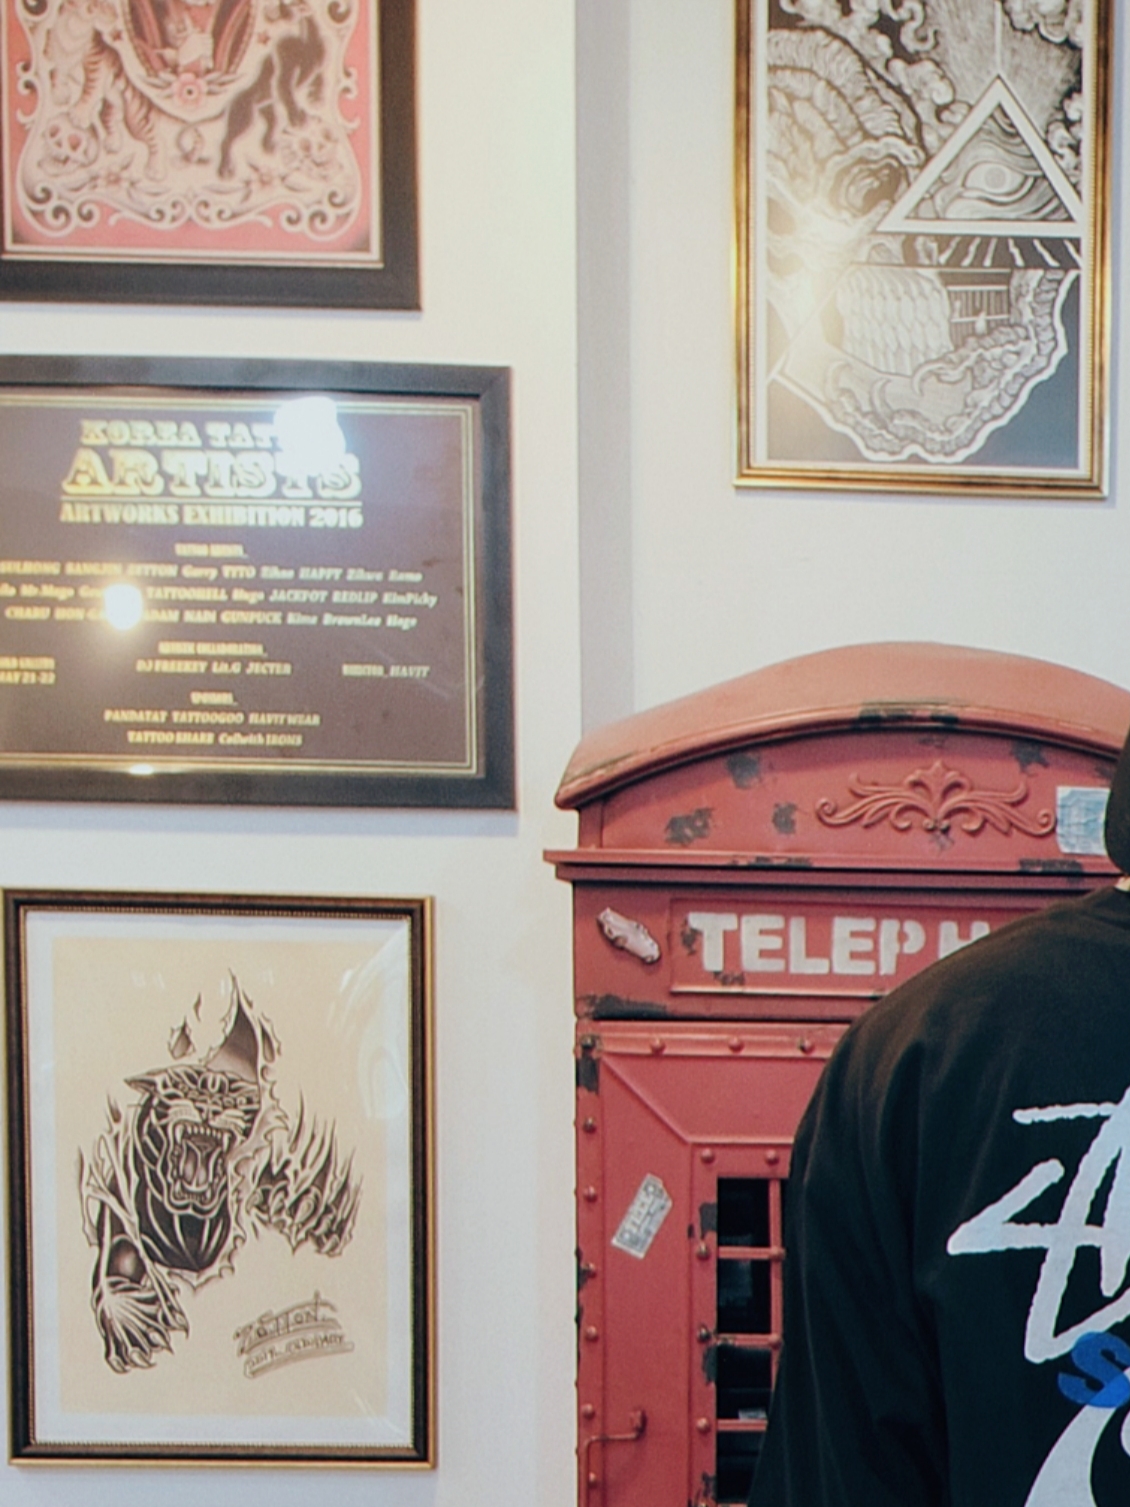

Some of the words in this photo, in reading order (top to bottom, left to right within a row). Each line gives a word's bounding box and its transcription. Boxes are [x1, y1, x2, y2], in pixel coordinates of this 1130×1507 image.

[80, 419, 202, 447] KOREA
[61, 447, 362, 499] ARTISTS
[59, 503, 179, 525] ARTWORKS
[182, 504, 305, 527] EXHIBITION
[309, 506, 363, 528] 2016
